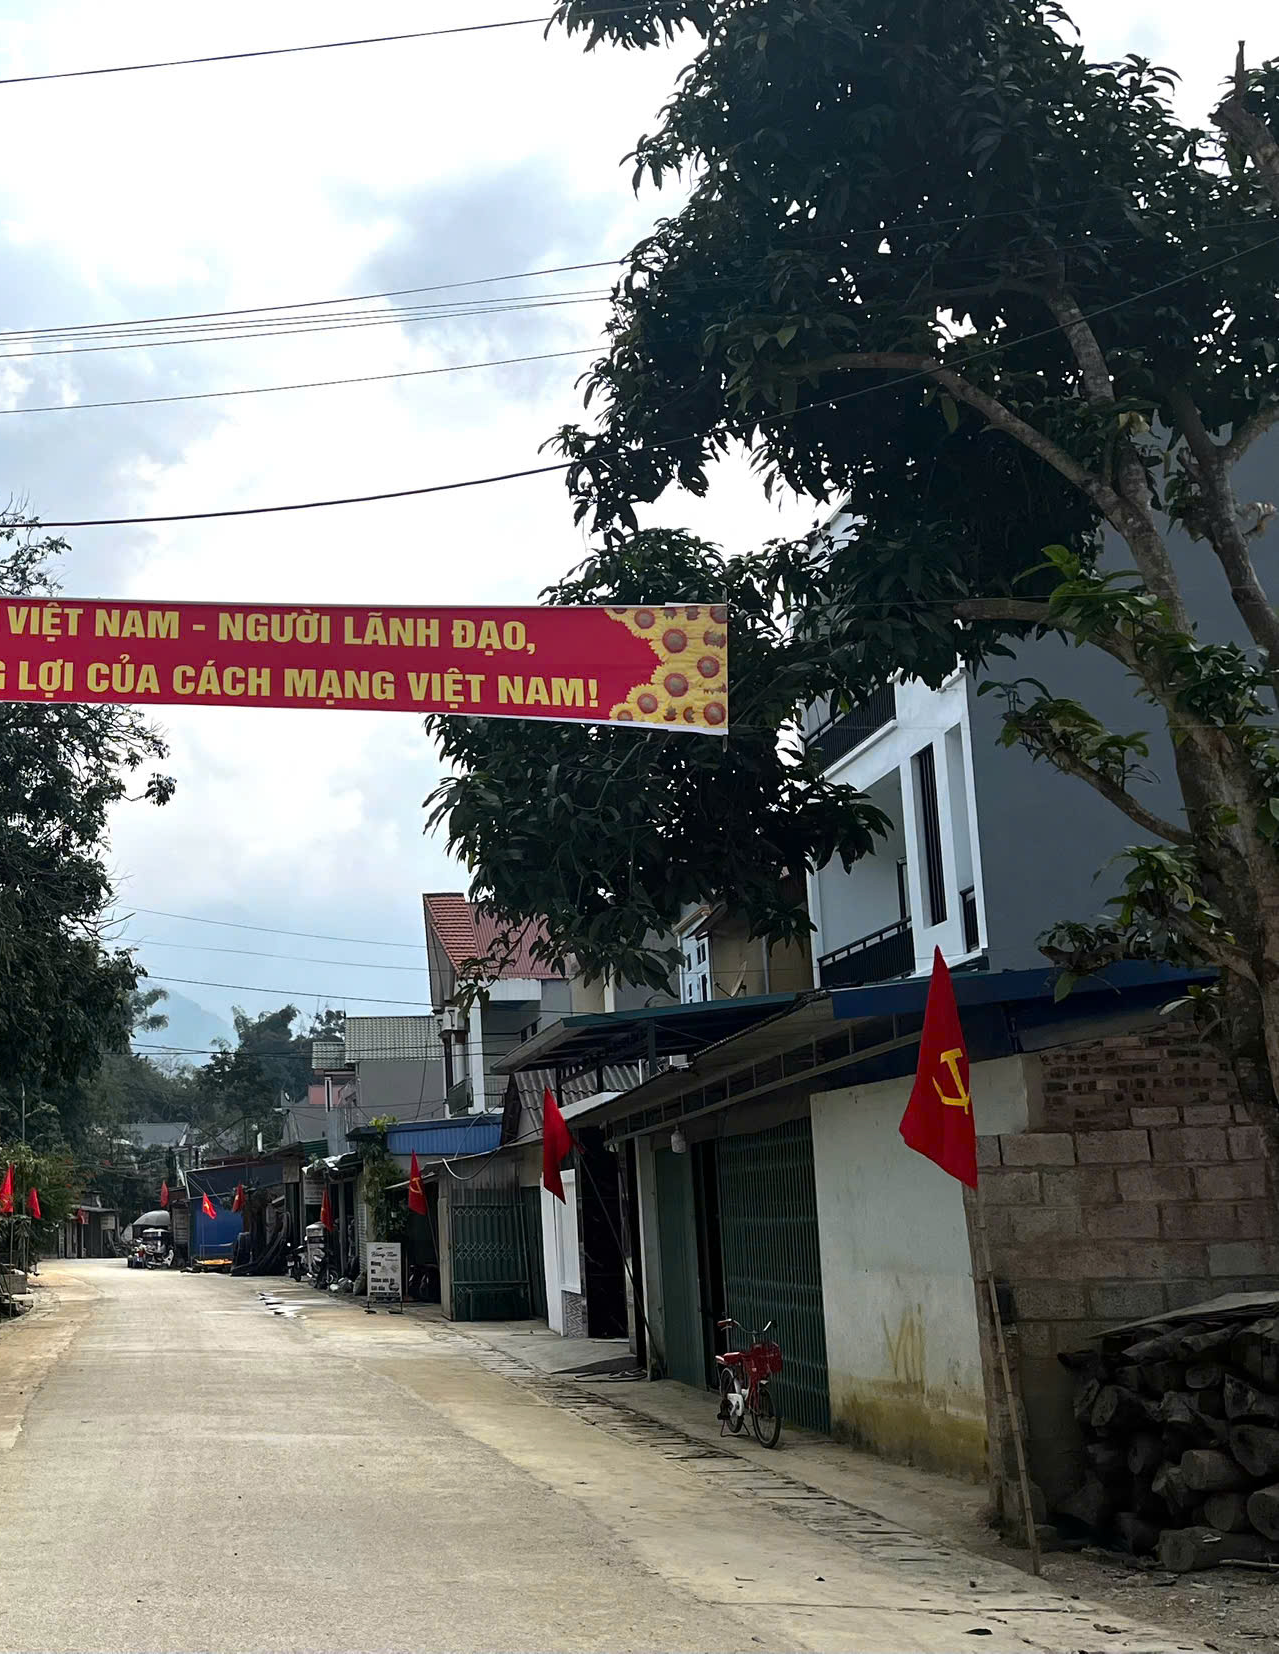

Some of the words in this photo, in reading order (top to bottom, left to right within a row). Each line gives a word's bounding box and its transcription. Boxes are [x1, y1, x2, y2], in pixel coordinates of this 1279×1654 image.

[8, 599, 82, 642] VIỆT
[96, 610, 180, 639] NAM
[219, 610, 331, 644] NGƯỜI
[345, 610, 440, 648] LÃNH
[452, 620, 536, 656] ĐẠO,
[19, 660, 74, 699] LỢI
[87, 655, 161, 694] CỦA
[173, 660, 271, 697] CÁCH
[284, 669, 395, 705] MẠNG
[408, 667, 486, 709] VIỆT
[498, 676, 599, 708] NAM!
